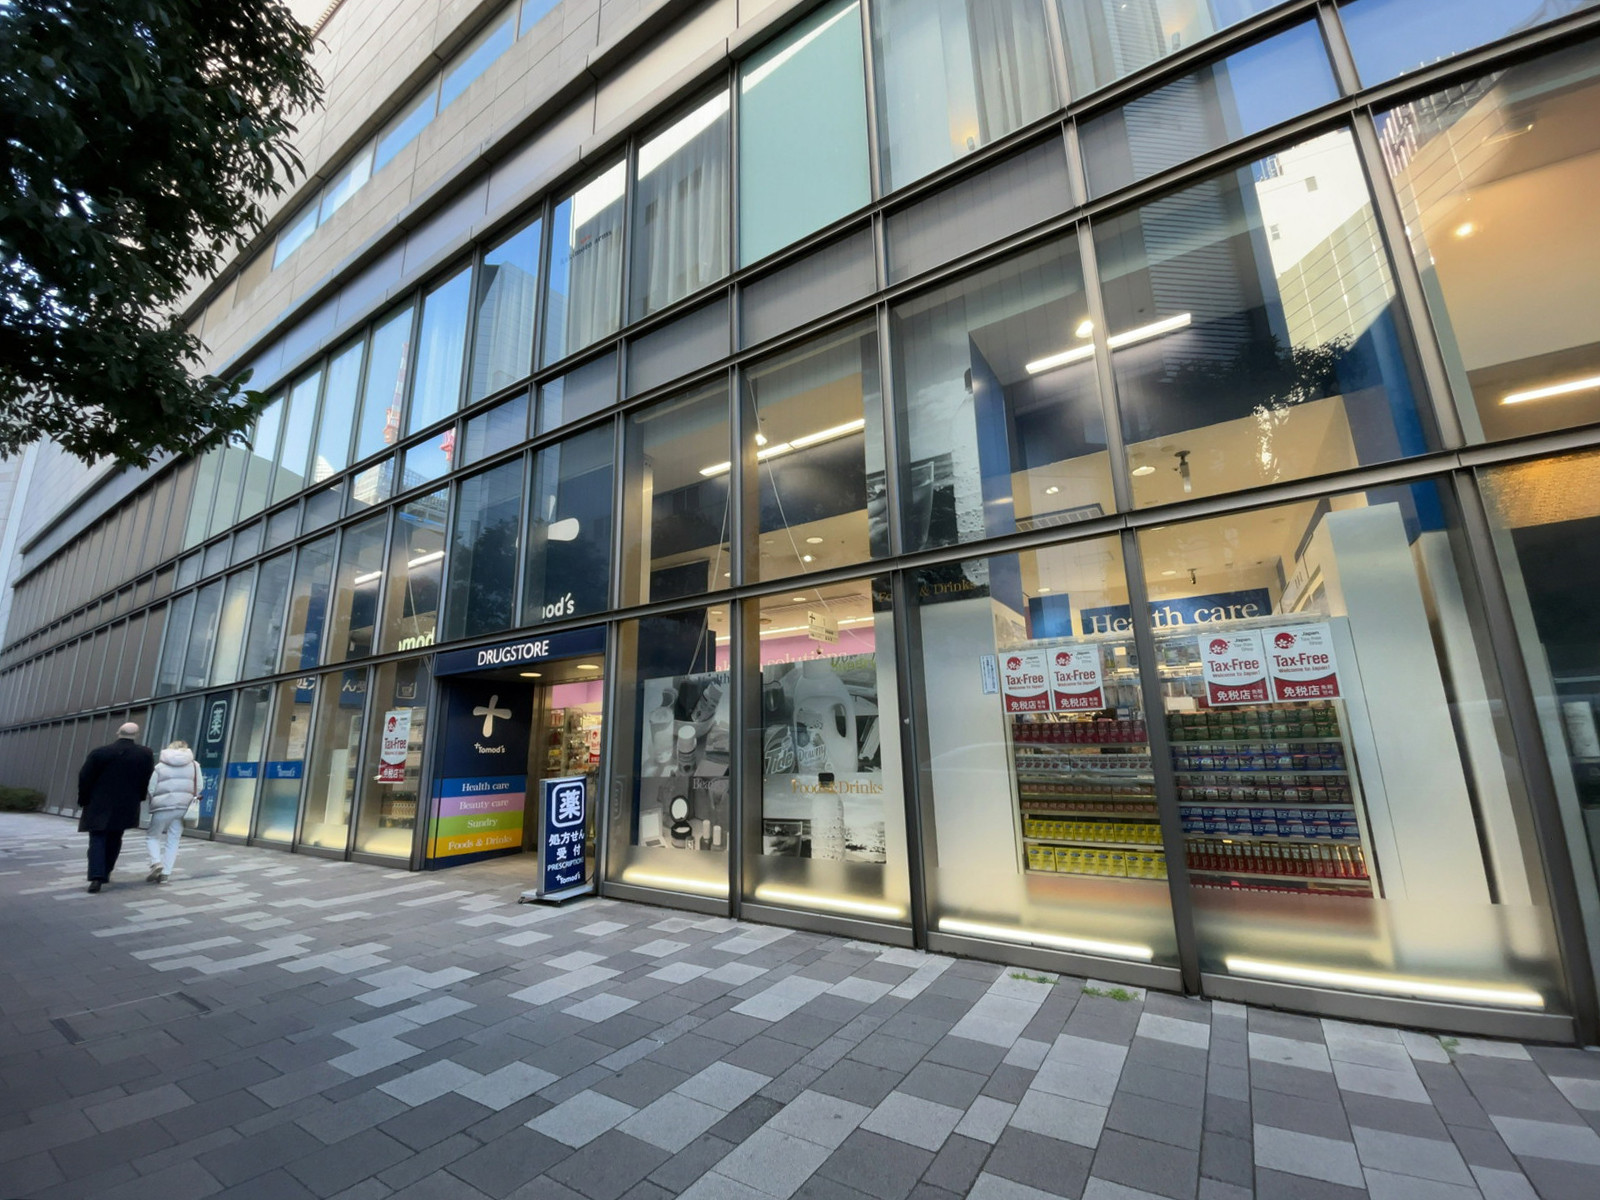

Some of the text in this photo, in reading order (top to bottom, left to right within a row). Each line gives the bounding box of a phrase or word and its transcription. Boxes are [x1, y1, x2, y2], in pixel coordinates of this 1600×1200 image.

[934, 579, 976, 595] Drinks
[1089, 603, 1259, 635] Heath care
[398, 626, 436, 652] mod
[477, 640, 550, 666] DRUGSTORE
[1207, 658, 1260, 672] Tax-Free
[1273, 653, 1329, 667] Tax-Free
[1005, 673, 1044, 686] Tax-Free
[1054, 669, 1096, 682] Tax-Free
[1217, 690, 1251, 702] 免税店
[1284, 685, 1320, 698] 免税店
[1011, 700, 1037, 711] 免税店
[1060, 697, 1088, 708] 免税店
[209, 707, 224, 736] 薬
[384, 737, 407, 750] Tax-Free
[478, 745, 506, 754] Tomod's
[462, 782, 510, 792] Health care
[839, 780, 884, 795] Drinks
[459, 799, 509, 810] Beauty care
[558, 789, 581, 820] 薬
[467, 818, 498, 829] Sundry
[448, 835, 513, 850] Foods & Drinks
[548, 829, 585, 847] 処方せん
